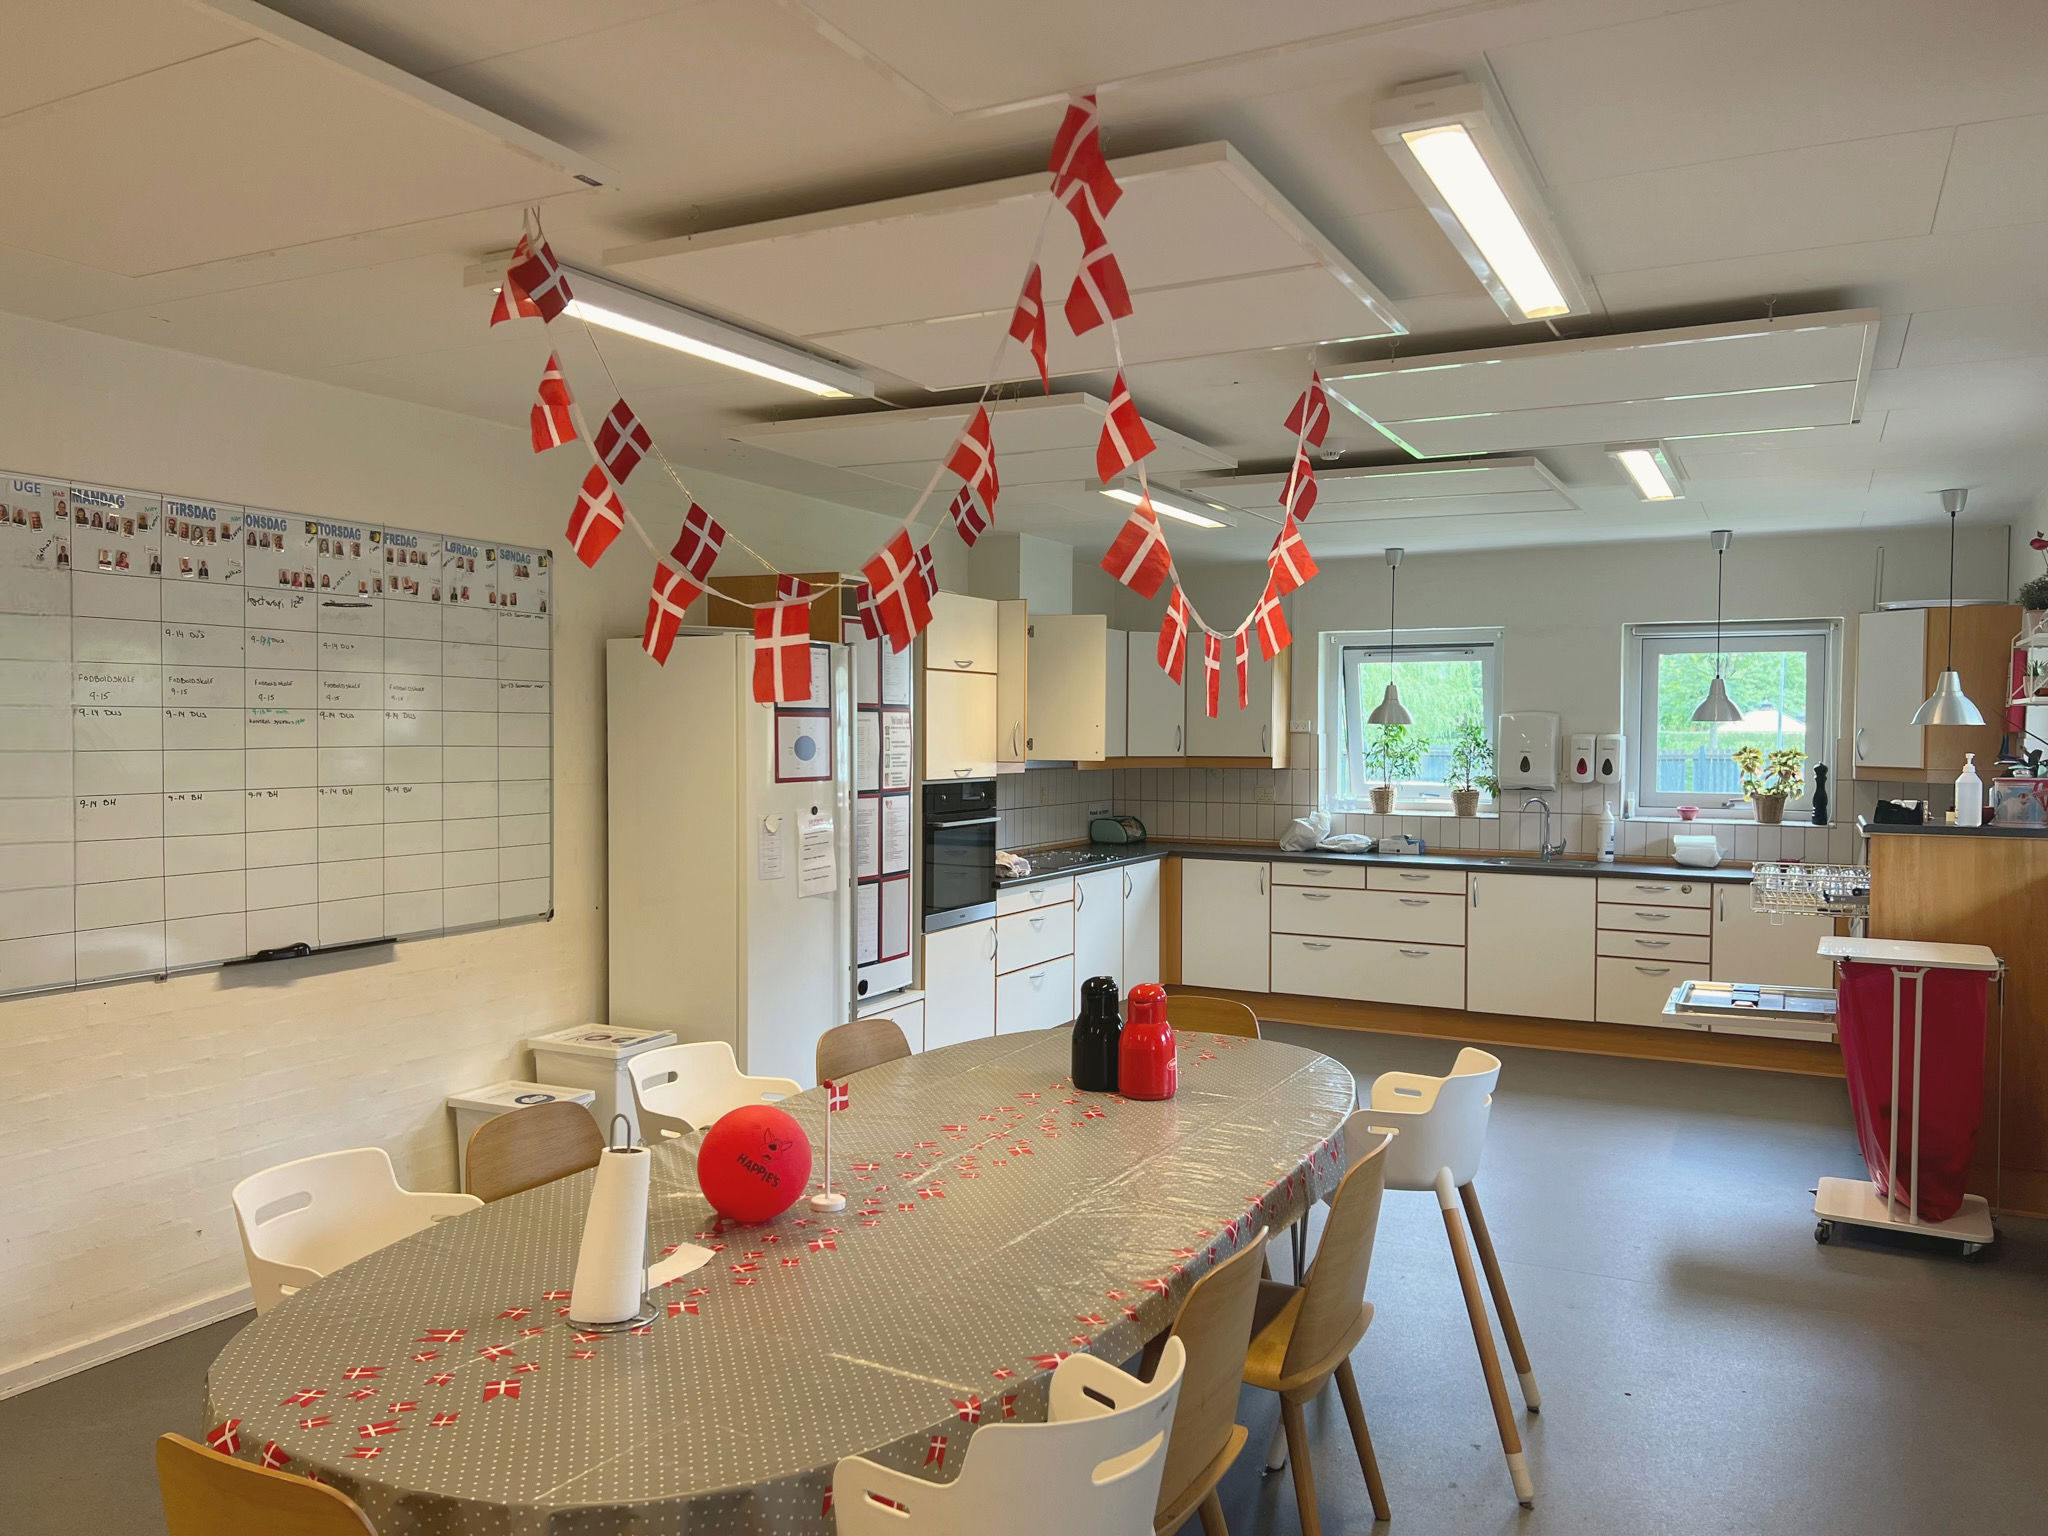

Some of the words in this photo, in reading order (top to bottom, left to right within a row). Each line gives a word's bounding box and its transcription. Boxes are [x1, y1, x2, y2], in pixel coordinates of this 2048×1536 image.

[14, 480, 41, 497] UGE
[72, 487, 125, 508] MANDAG
[246, 515, 287, 532] ONSDAG
[318, 520, 361, 541] TORSDAG
[384, 532, 418, 548] FREDAG
[445, 541, 478, 558] LØRDAG
[500, 548, 531, 565] SØNDAG
[165, 629, 184, 638] 9-14
[89, 692, 111, 700] 9-15
[171, 688, 188, 696] 9-15
[258, 694, 275, 702] 9-15
[78, 708, 99, 717] 9-14
[166, 710, 185, 718] 9-14
[79, 800, 98, 808] 9-14
[736, 1152, 780, 1188] HAPPIES
